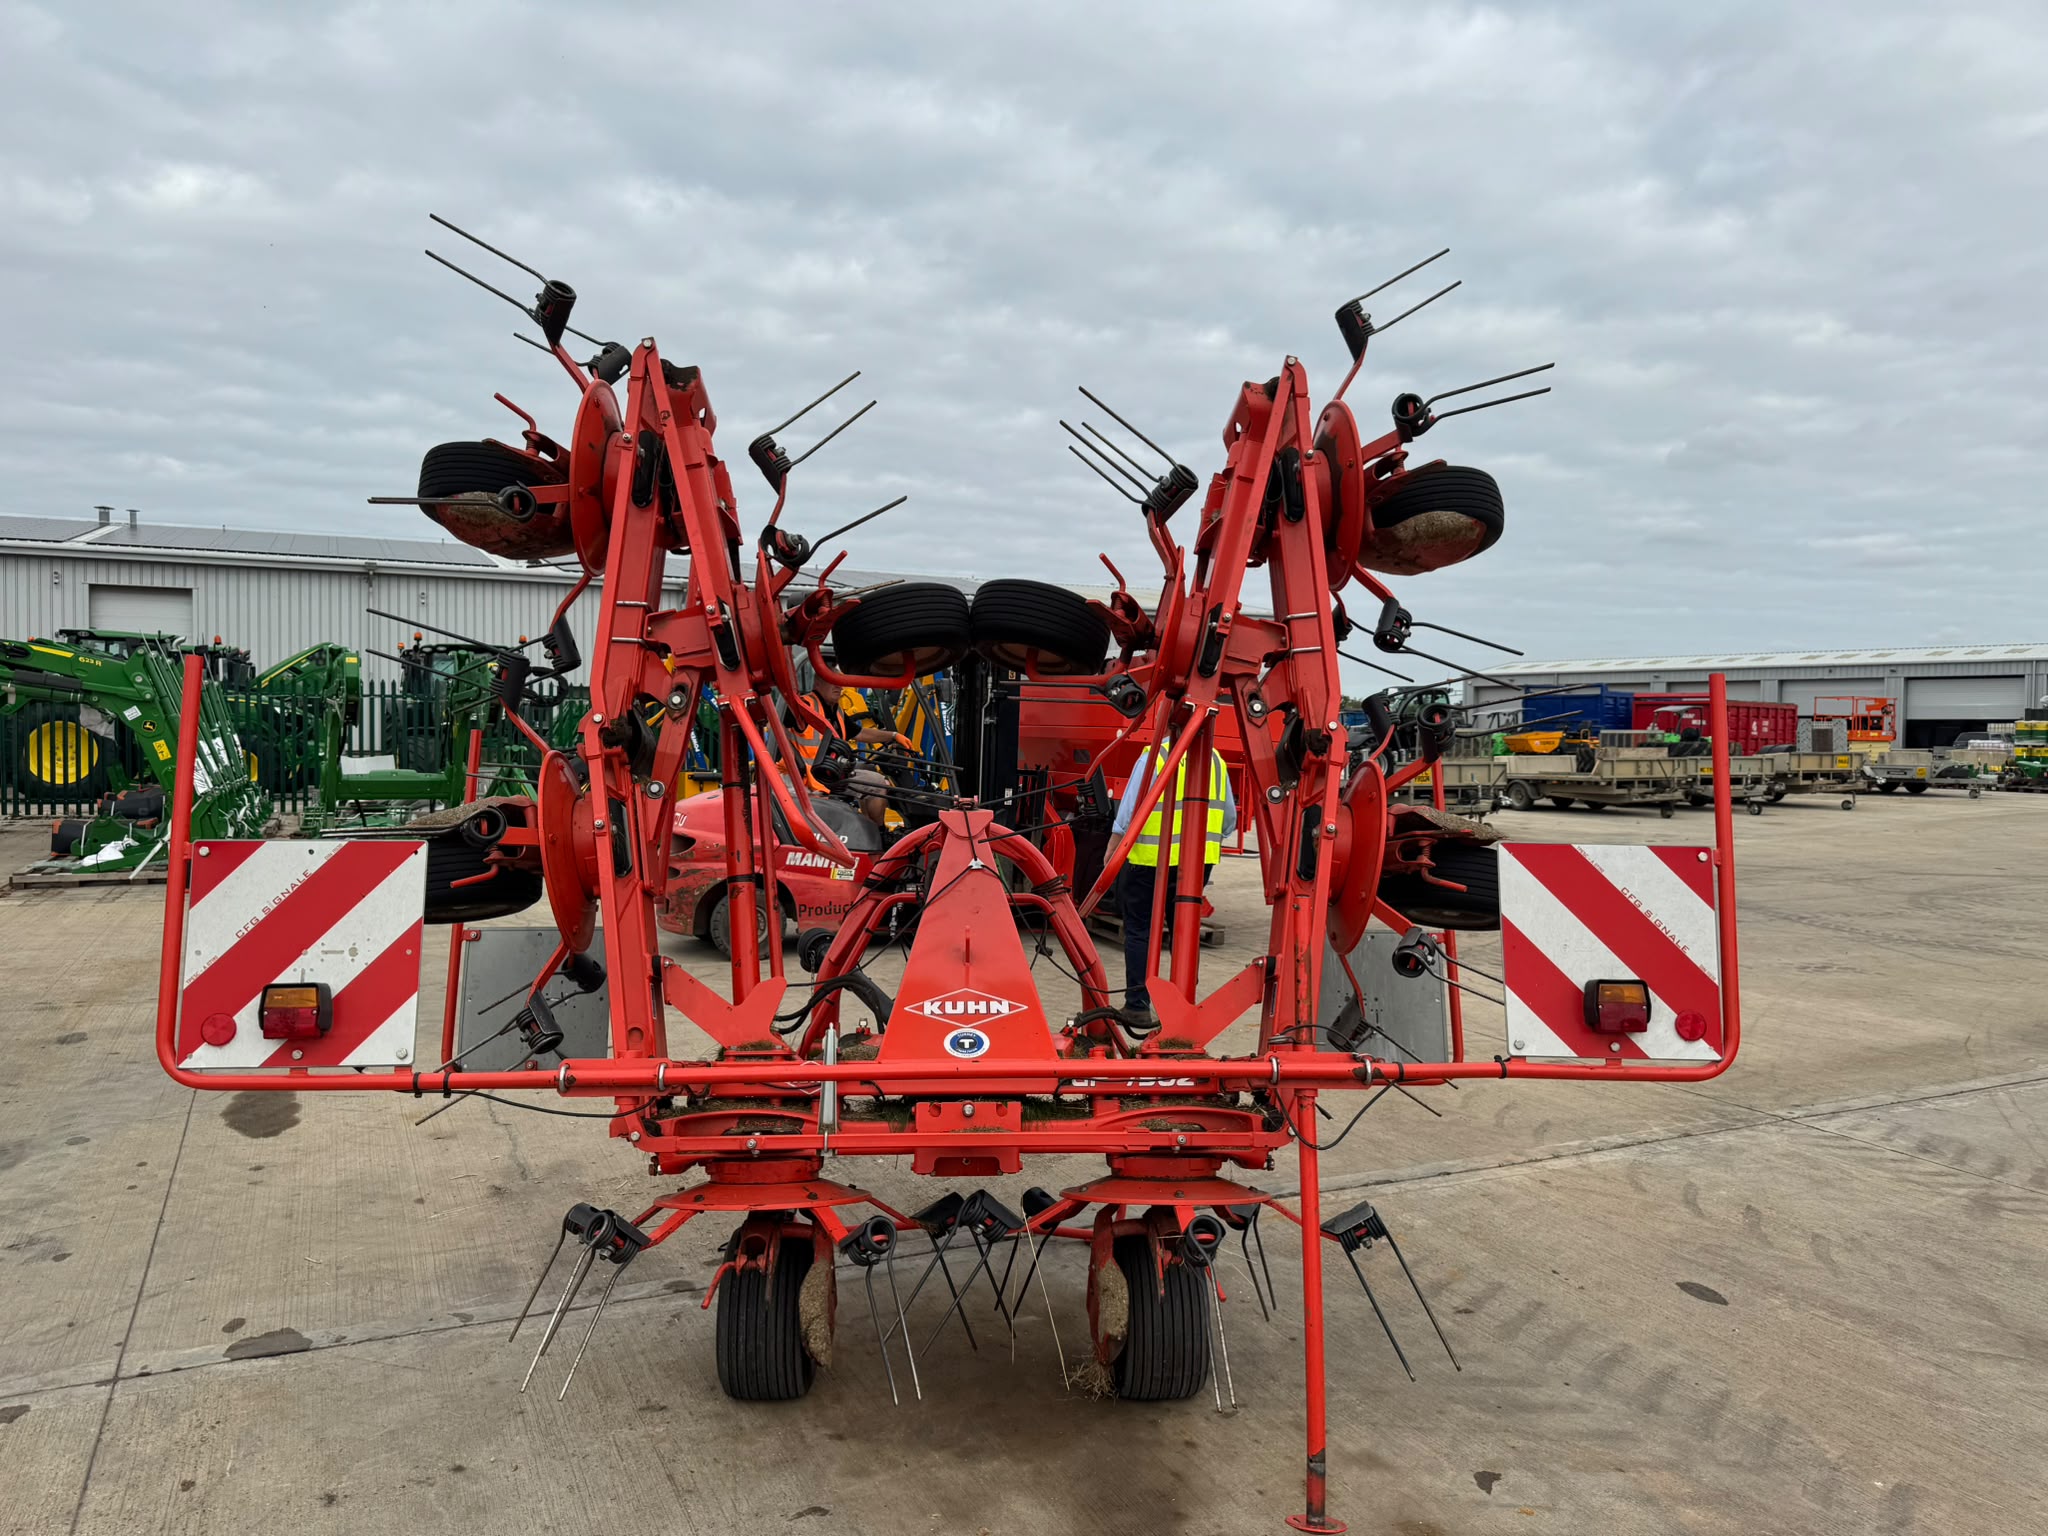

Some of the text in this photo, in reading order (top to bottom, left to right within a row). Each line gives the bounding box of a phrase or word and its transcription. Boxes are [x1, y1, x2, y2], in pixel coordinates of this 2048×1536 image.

[1620, 887, 1643, 908] CFG
[235, 916, 260, 939] CFG
[923, 1000, 1010, 1015] KUHN
